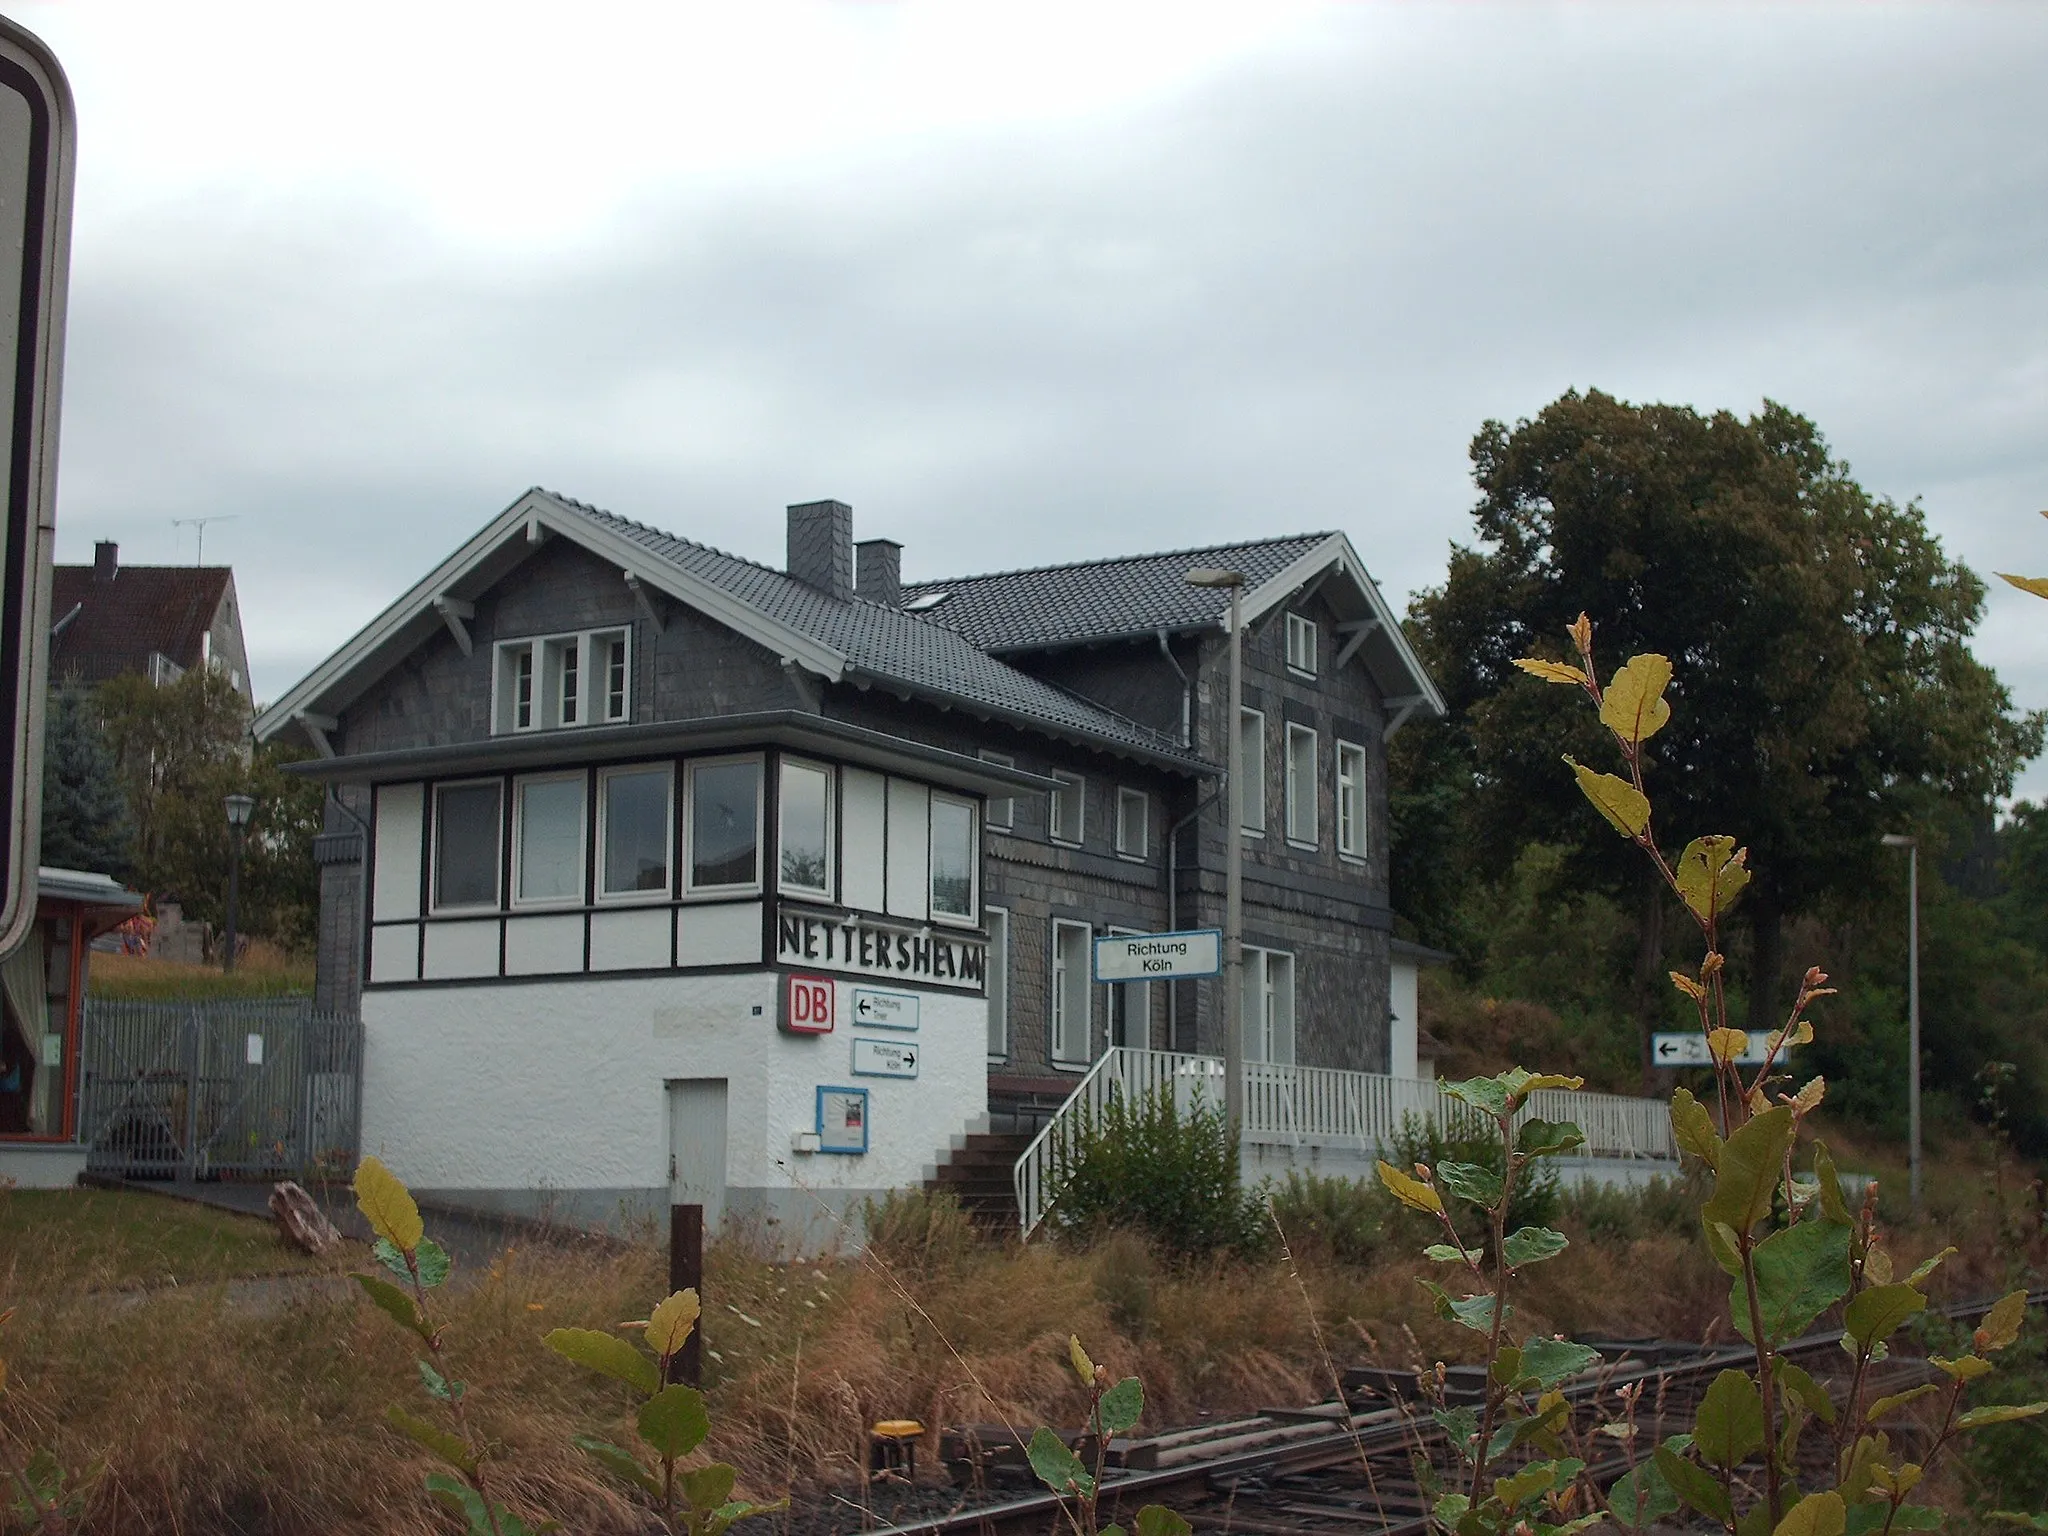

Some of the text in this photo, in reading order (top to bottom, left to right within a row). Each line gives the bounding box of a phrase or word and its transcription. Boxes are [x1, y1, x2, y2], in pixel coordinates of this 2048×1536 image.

[779, 914, 984, 982] NETTERSHEIM
[1127, 942, 1187, 957] Richtung
[1142, 959, 1173, 972] Köln
[795, 984, 828, 1023] DB
[873, 997, 901, 1012] Richtung
[873, 1045, 902, 1060] Richtung
